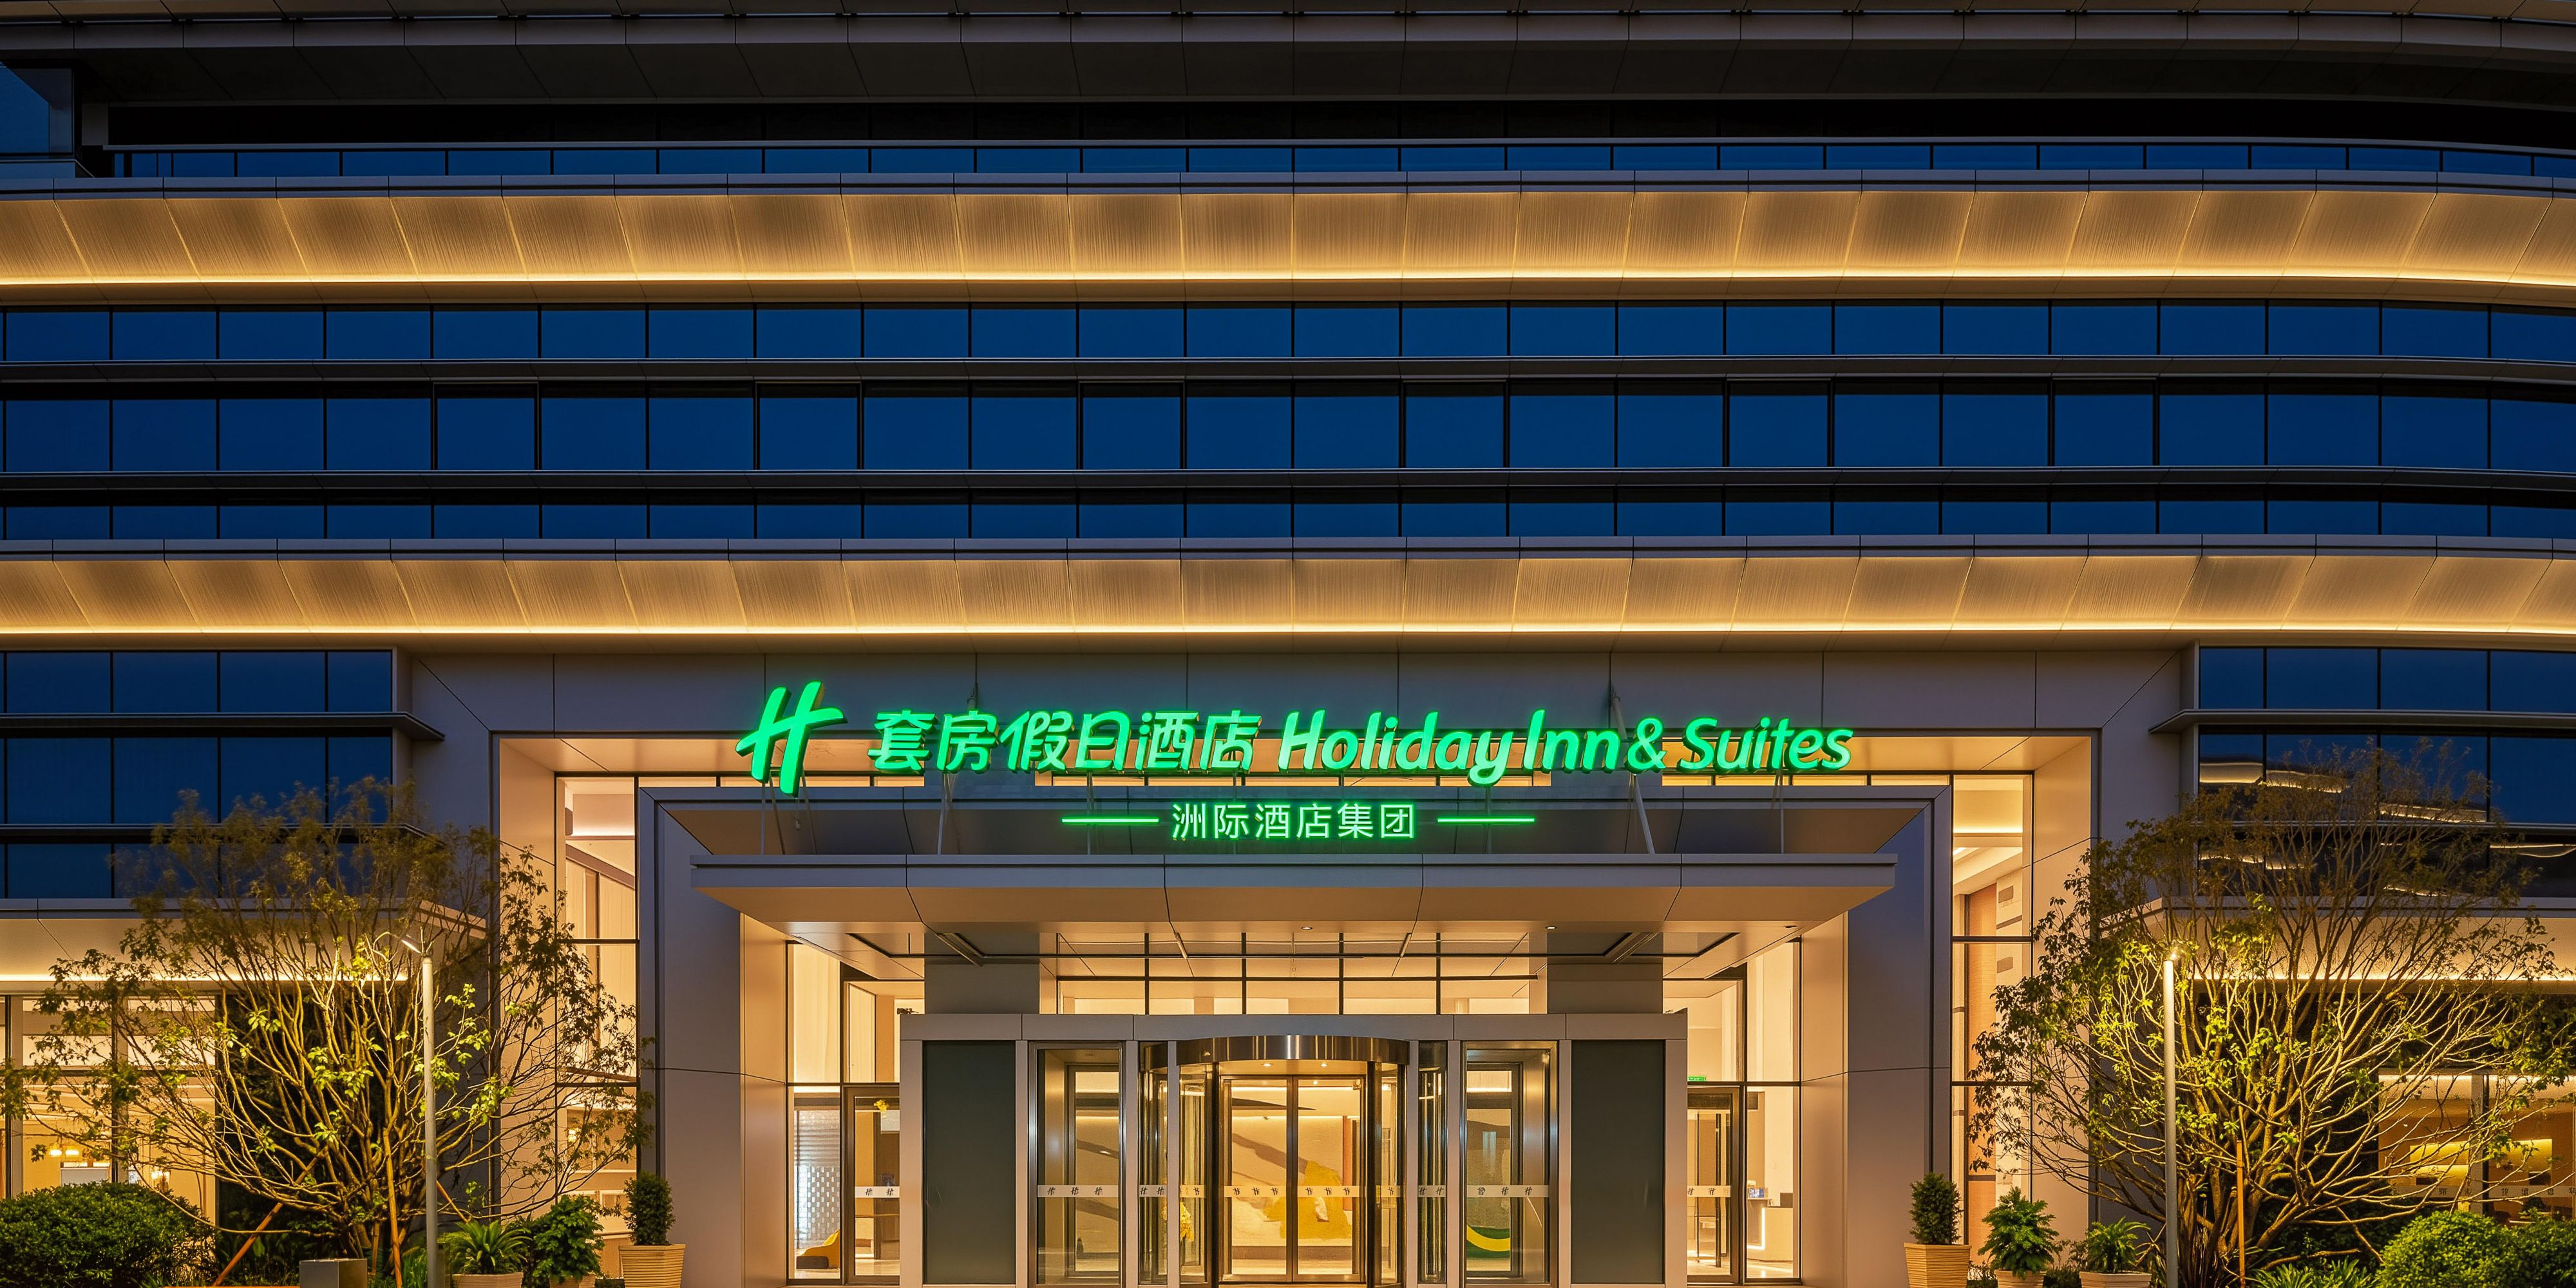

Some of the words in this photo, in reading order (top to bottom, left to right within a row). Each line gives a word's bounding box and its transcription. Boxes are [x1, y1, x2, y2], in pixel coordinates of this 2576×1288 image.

[867, 709, 1262, 772] 套房假日酒店
[1277, 709, 1515, 786] Holiday
[1523, 708, 1622, 771] Inn
[1626, 717, 1667, 771] &
[1678, 717, 1854, 771] Suites
[1171, 802, 1416, 840] 洲际酒店集团
